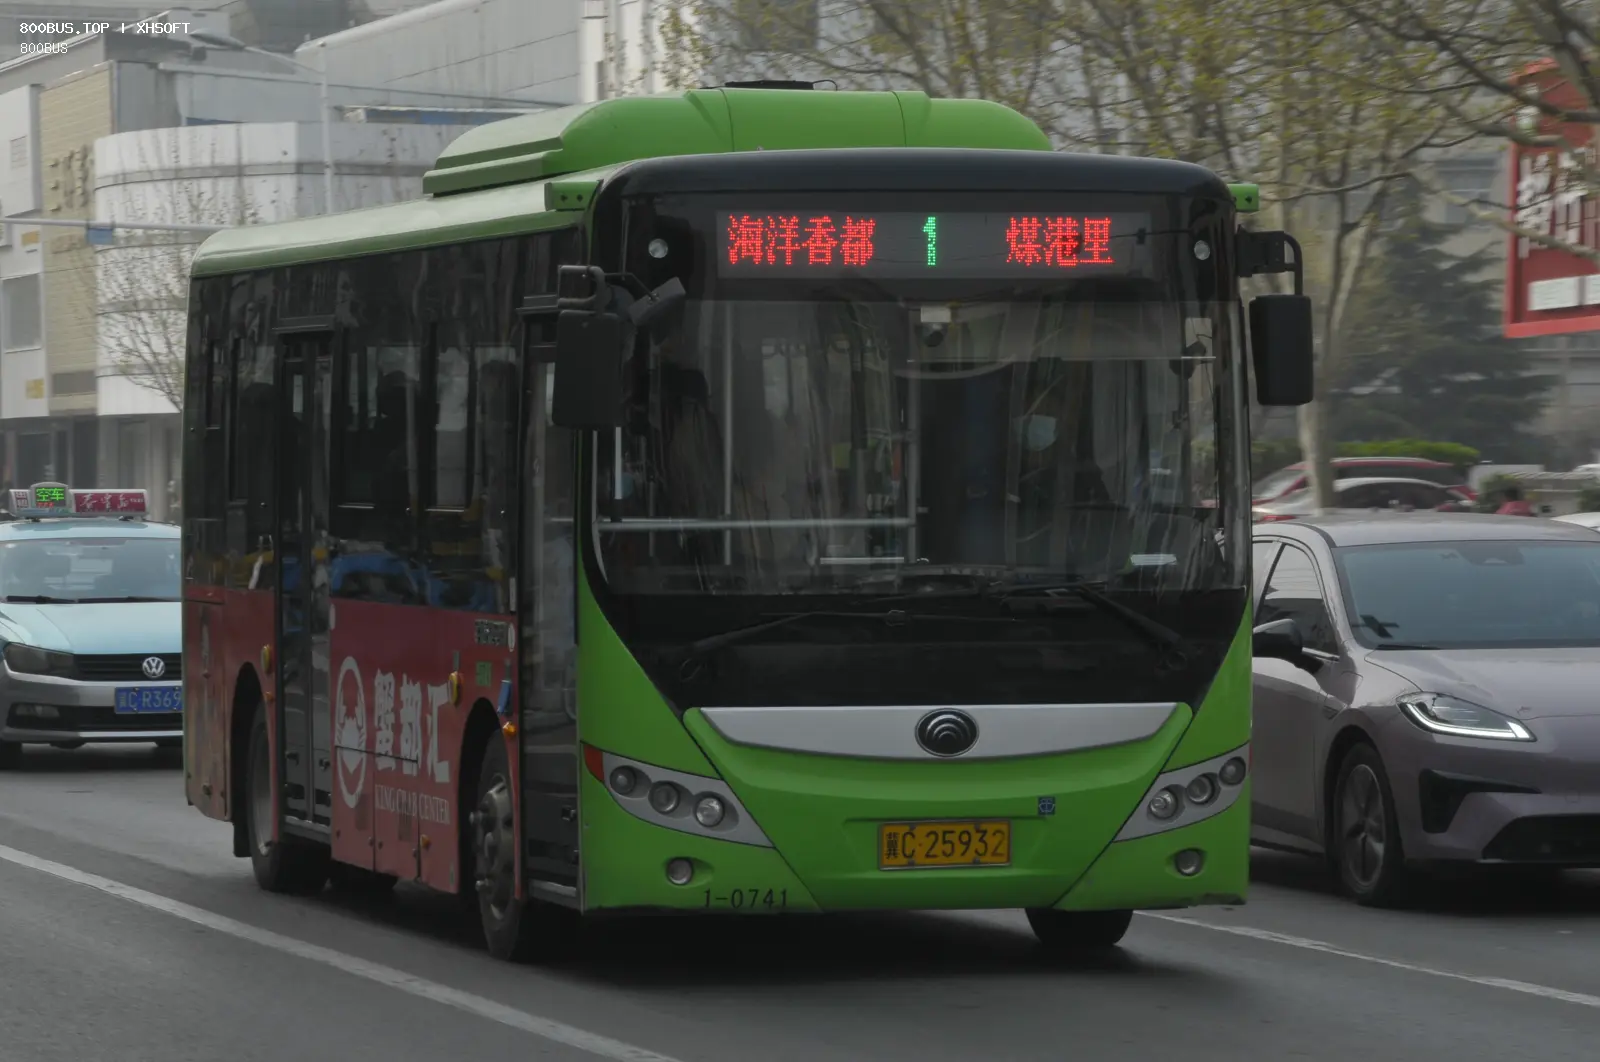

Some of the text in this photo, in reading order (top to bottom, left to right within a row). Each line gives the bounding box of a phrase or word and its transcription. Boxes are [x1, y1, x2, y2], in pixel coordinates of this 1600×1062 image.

[727, 215, 876, 266] 海洋香都
[921, 216, 937, 266] 1
[1005, 216, 1115, 267] 煤港里
[36, 487, 65, 502] 空车
[419, 792, 451, 825] CENTER
[703, 887, 787, 909] 1-0741
